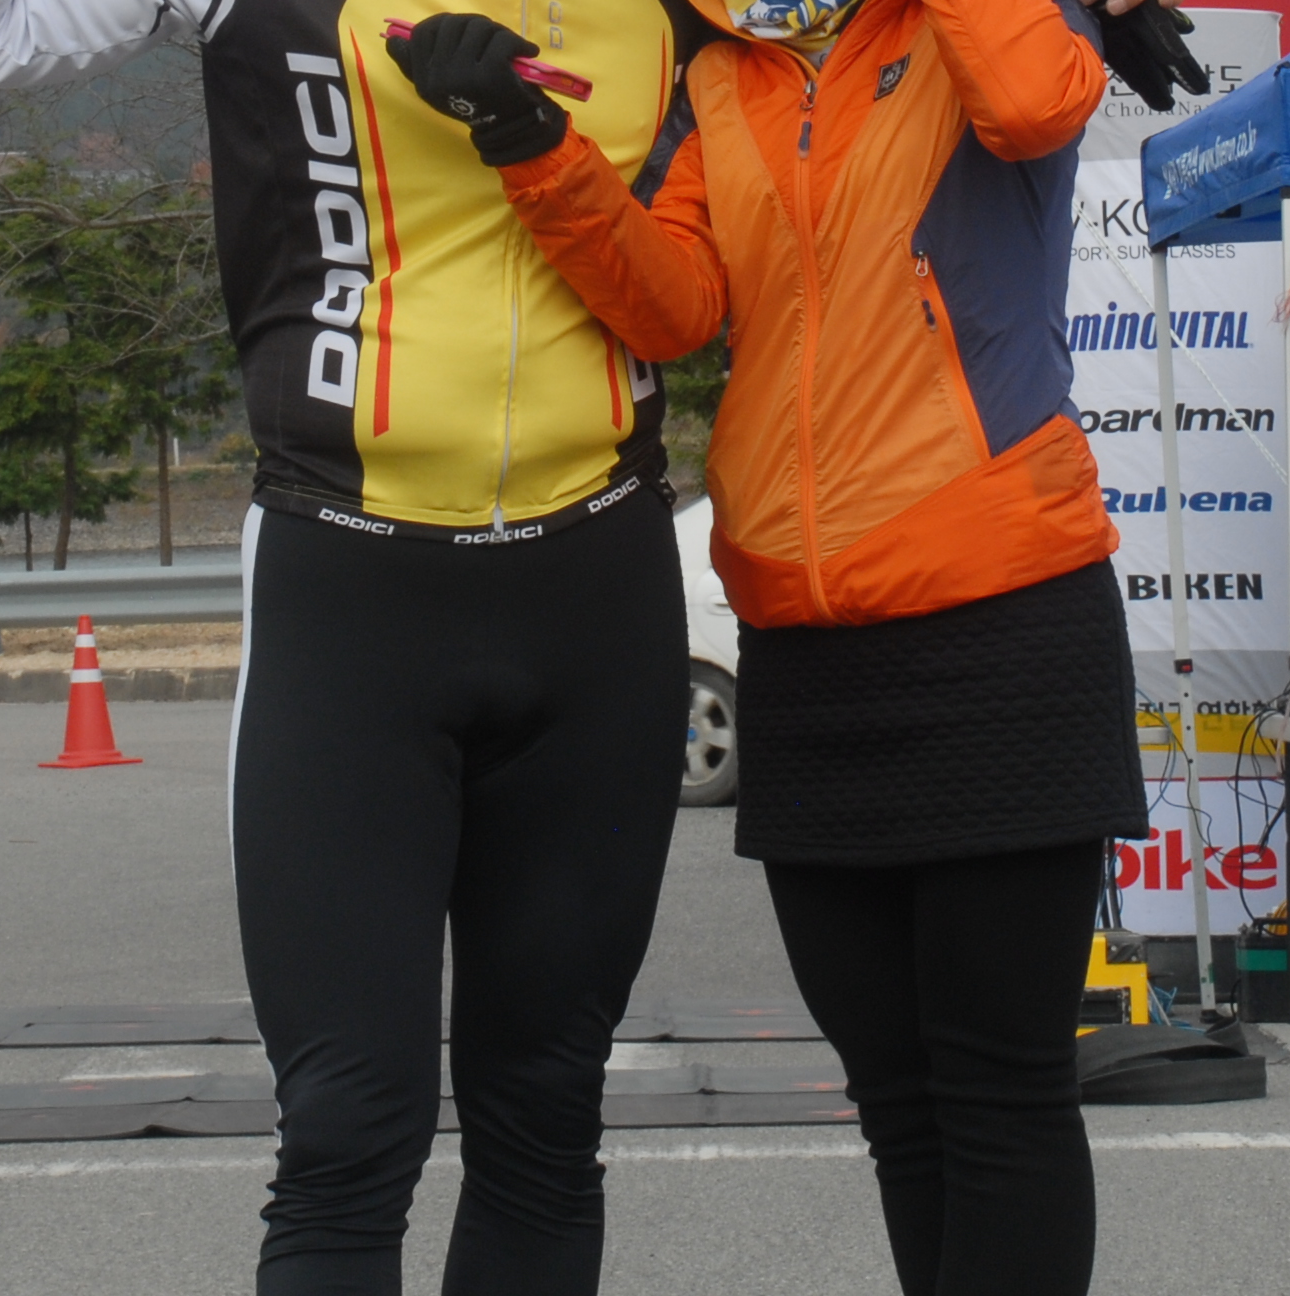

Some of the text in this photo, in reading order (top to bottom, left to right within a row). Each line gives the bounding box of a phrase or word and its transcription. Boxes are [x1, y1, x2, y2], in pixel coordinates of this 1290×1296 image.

[286, 51, 372, 408] DODICI
[1117, 244, 1236, 260] SUNLASSES
[1065, 301, 1250, 352] minoVITAL
[588, 476, 640, 513] DODICI
[318, 507, 395, 536] DODICI
[1127, 574, 1263, 601] BIKEN
